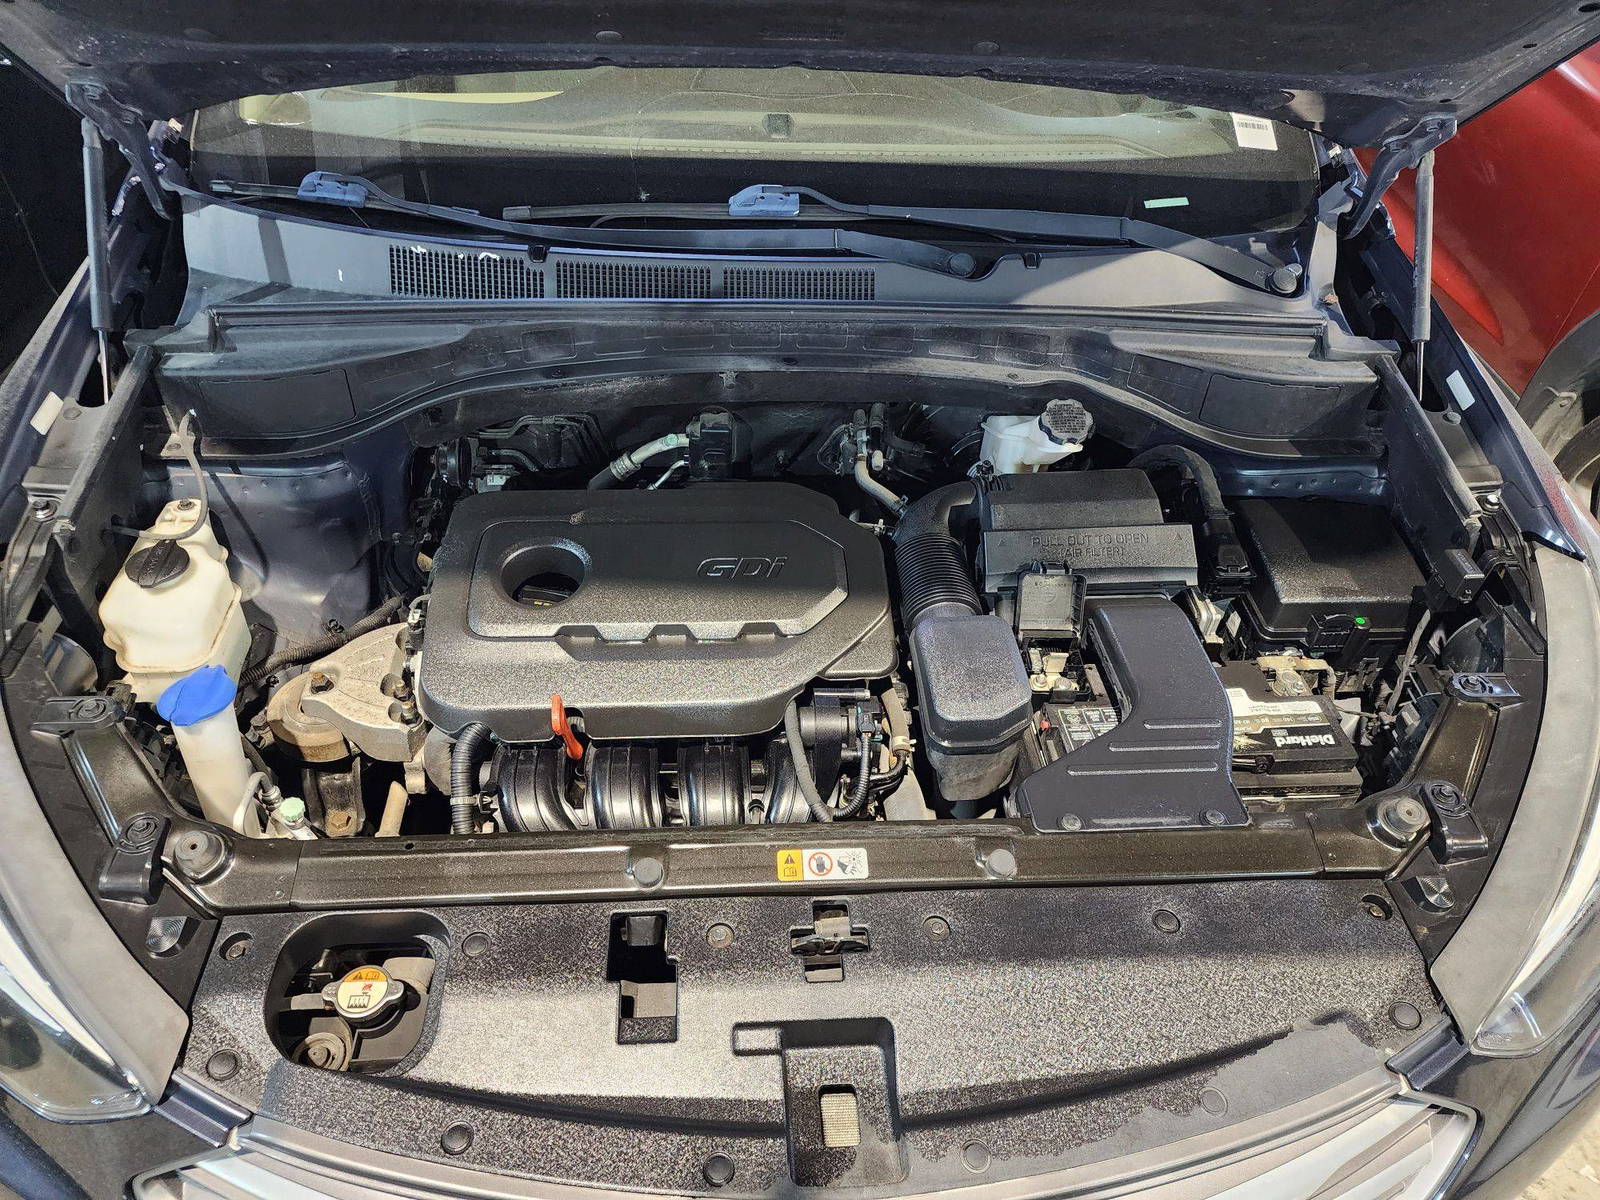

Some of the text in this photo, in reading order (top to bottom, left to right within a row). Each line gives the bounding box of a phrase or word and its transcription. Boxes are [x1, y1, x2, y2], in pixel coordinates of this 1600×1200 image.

[1031, 533, 1149, 548] PULL OUT TO OPEN
[1275, 734, 1336, 747] DieHard
